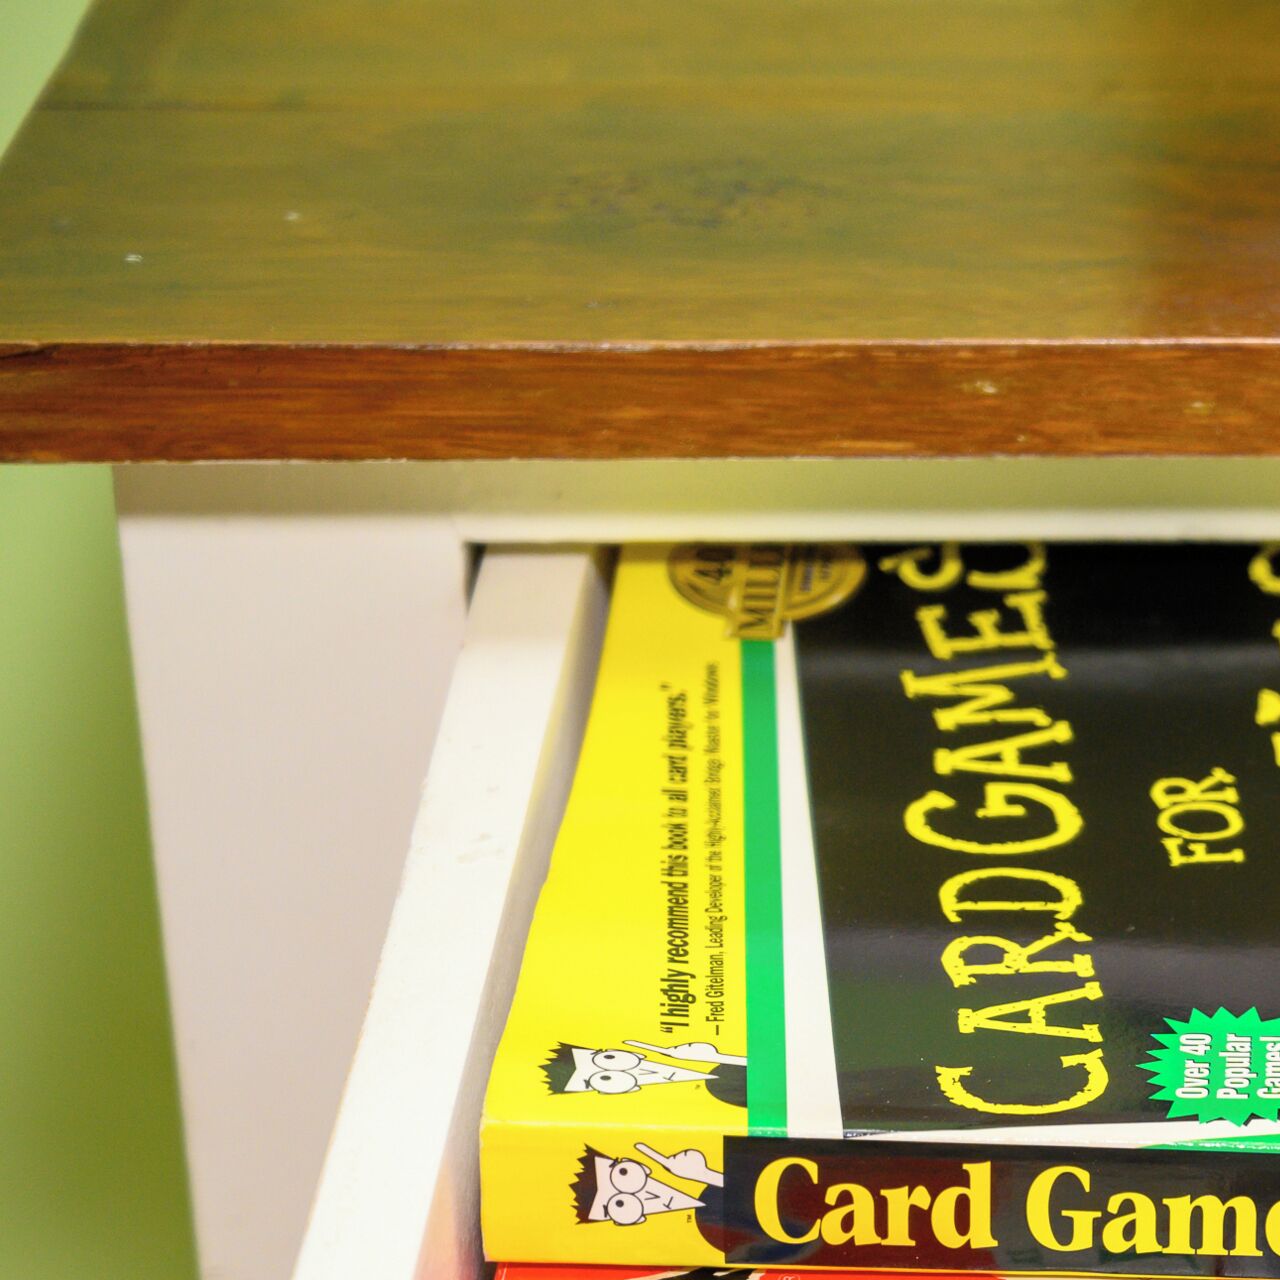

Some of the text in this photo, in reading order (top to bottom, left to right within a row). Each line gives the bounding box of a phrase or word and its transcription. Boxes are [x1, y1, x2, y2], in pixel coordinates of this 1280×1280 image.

[660, 822, 688, 851] book
[1151, 767, 1245, 867] FOR
[660, 854, 689, 878] this
[660, 880, 690, 964] recommend
[705, 915, 728, 948] Leading
[660, 968, 697, 1018] highly
[936, 867, 1109, 1115] CARD
[1175, 1033, 1212, 1099] Over 40
[1216, 1033, 1258, 1099] Popular
[753, 1156, 999, 1250] Card
